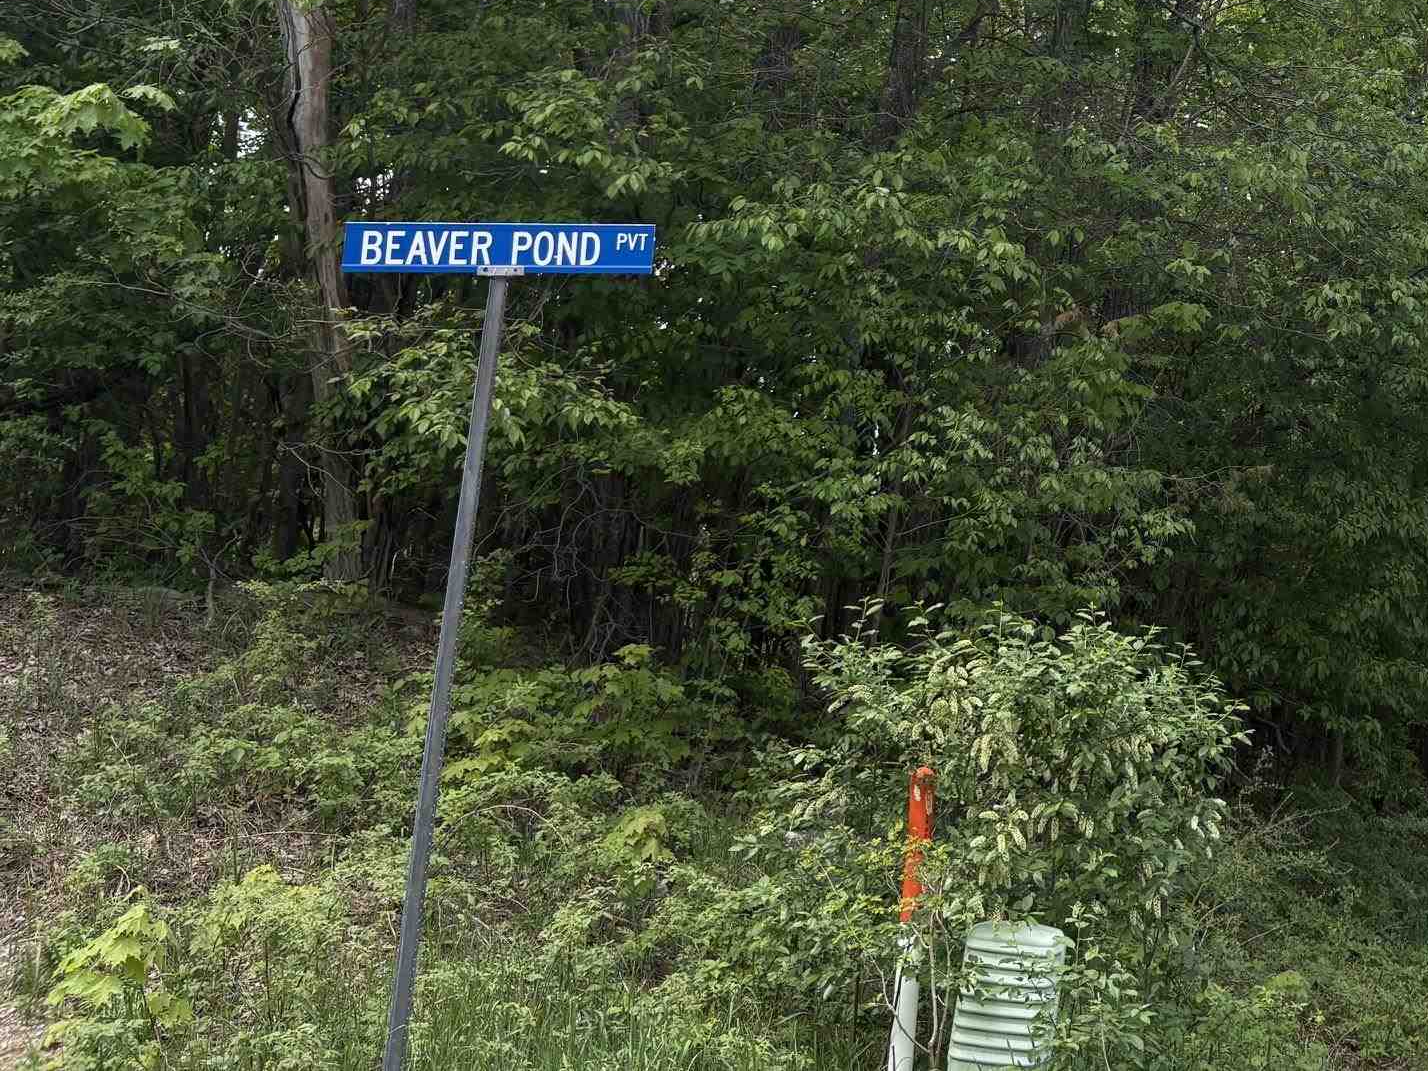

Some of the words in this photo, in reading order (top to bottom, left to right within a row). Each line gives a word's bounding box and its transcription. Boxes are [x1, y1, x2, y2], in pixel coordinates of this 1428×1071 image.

[360, 230, 493, 266] BEAVER
[511, 231, 601, 266] POND
[616, 233, 649, 251] PVT
